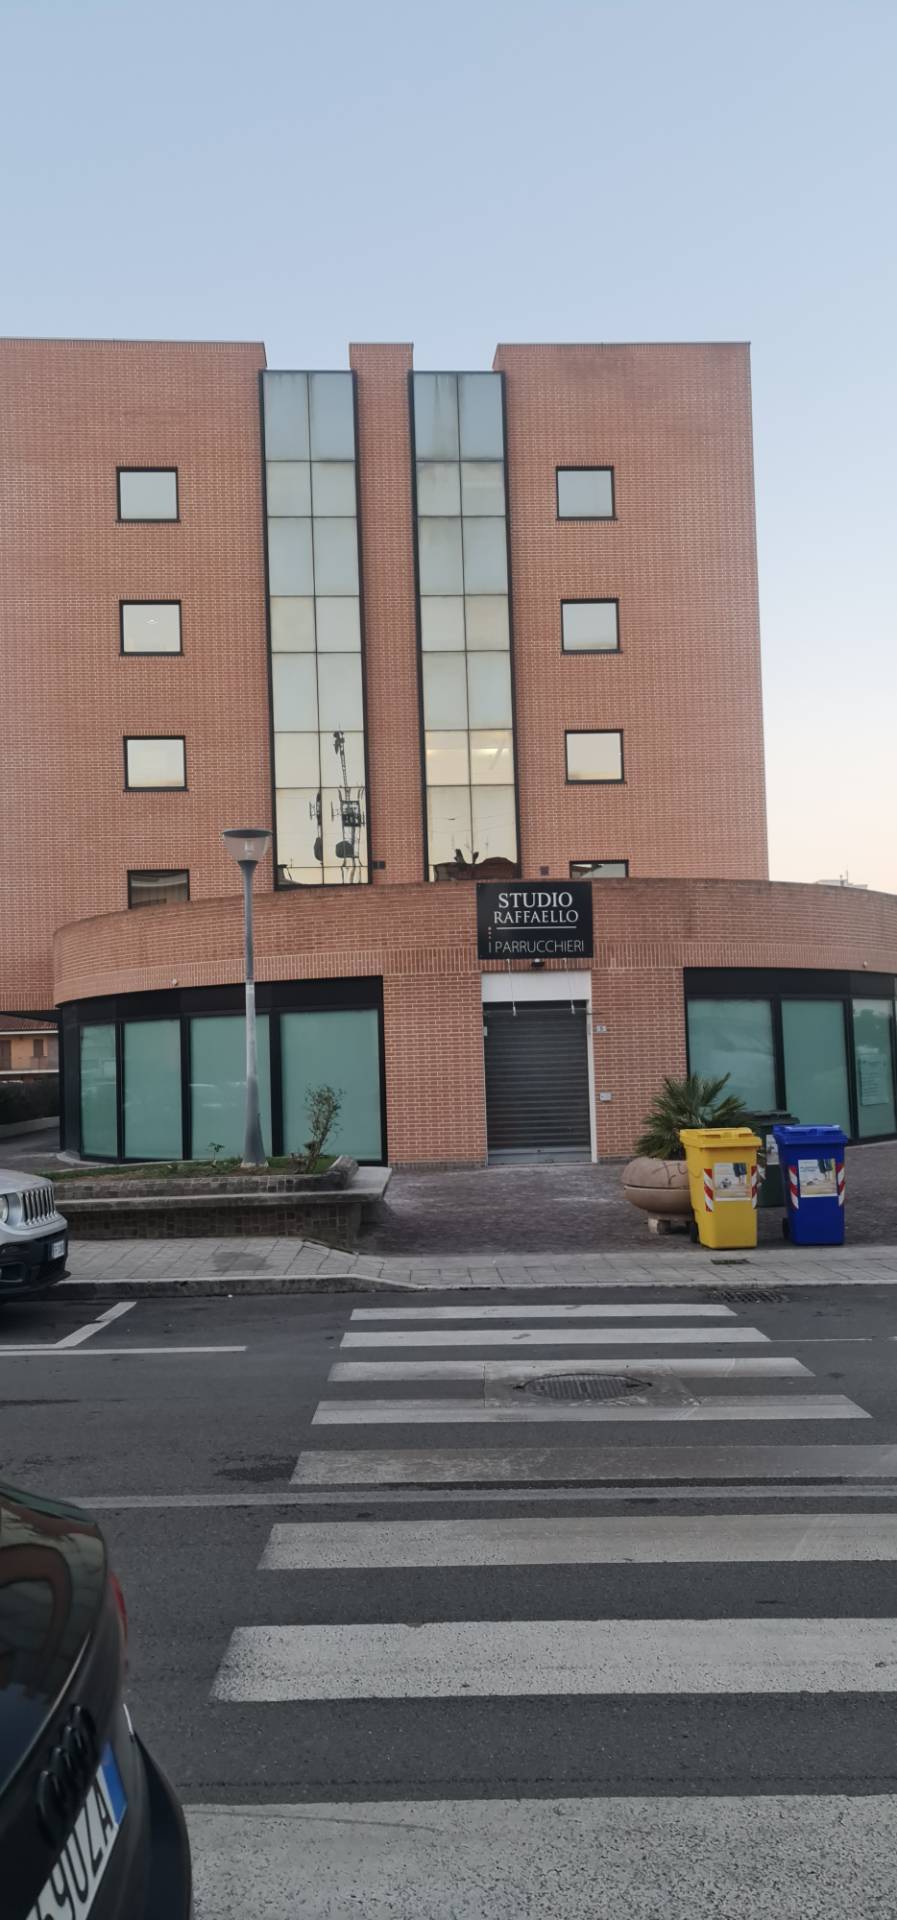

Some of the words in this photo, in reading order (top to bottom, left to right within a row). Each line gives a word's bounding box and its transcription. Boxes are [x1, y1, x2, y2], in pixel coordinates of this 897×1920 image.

[498, 892, 573, 908] STUDIO
[493, 910, 579, 924] RAFFAELLO
[495, 940, 584, 953] PARRUCCHIERI
